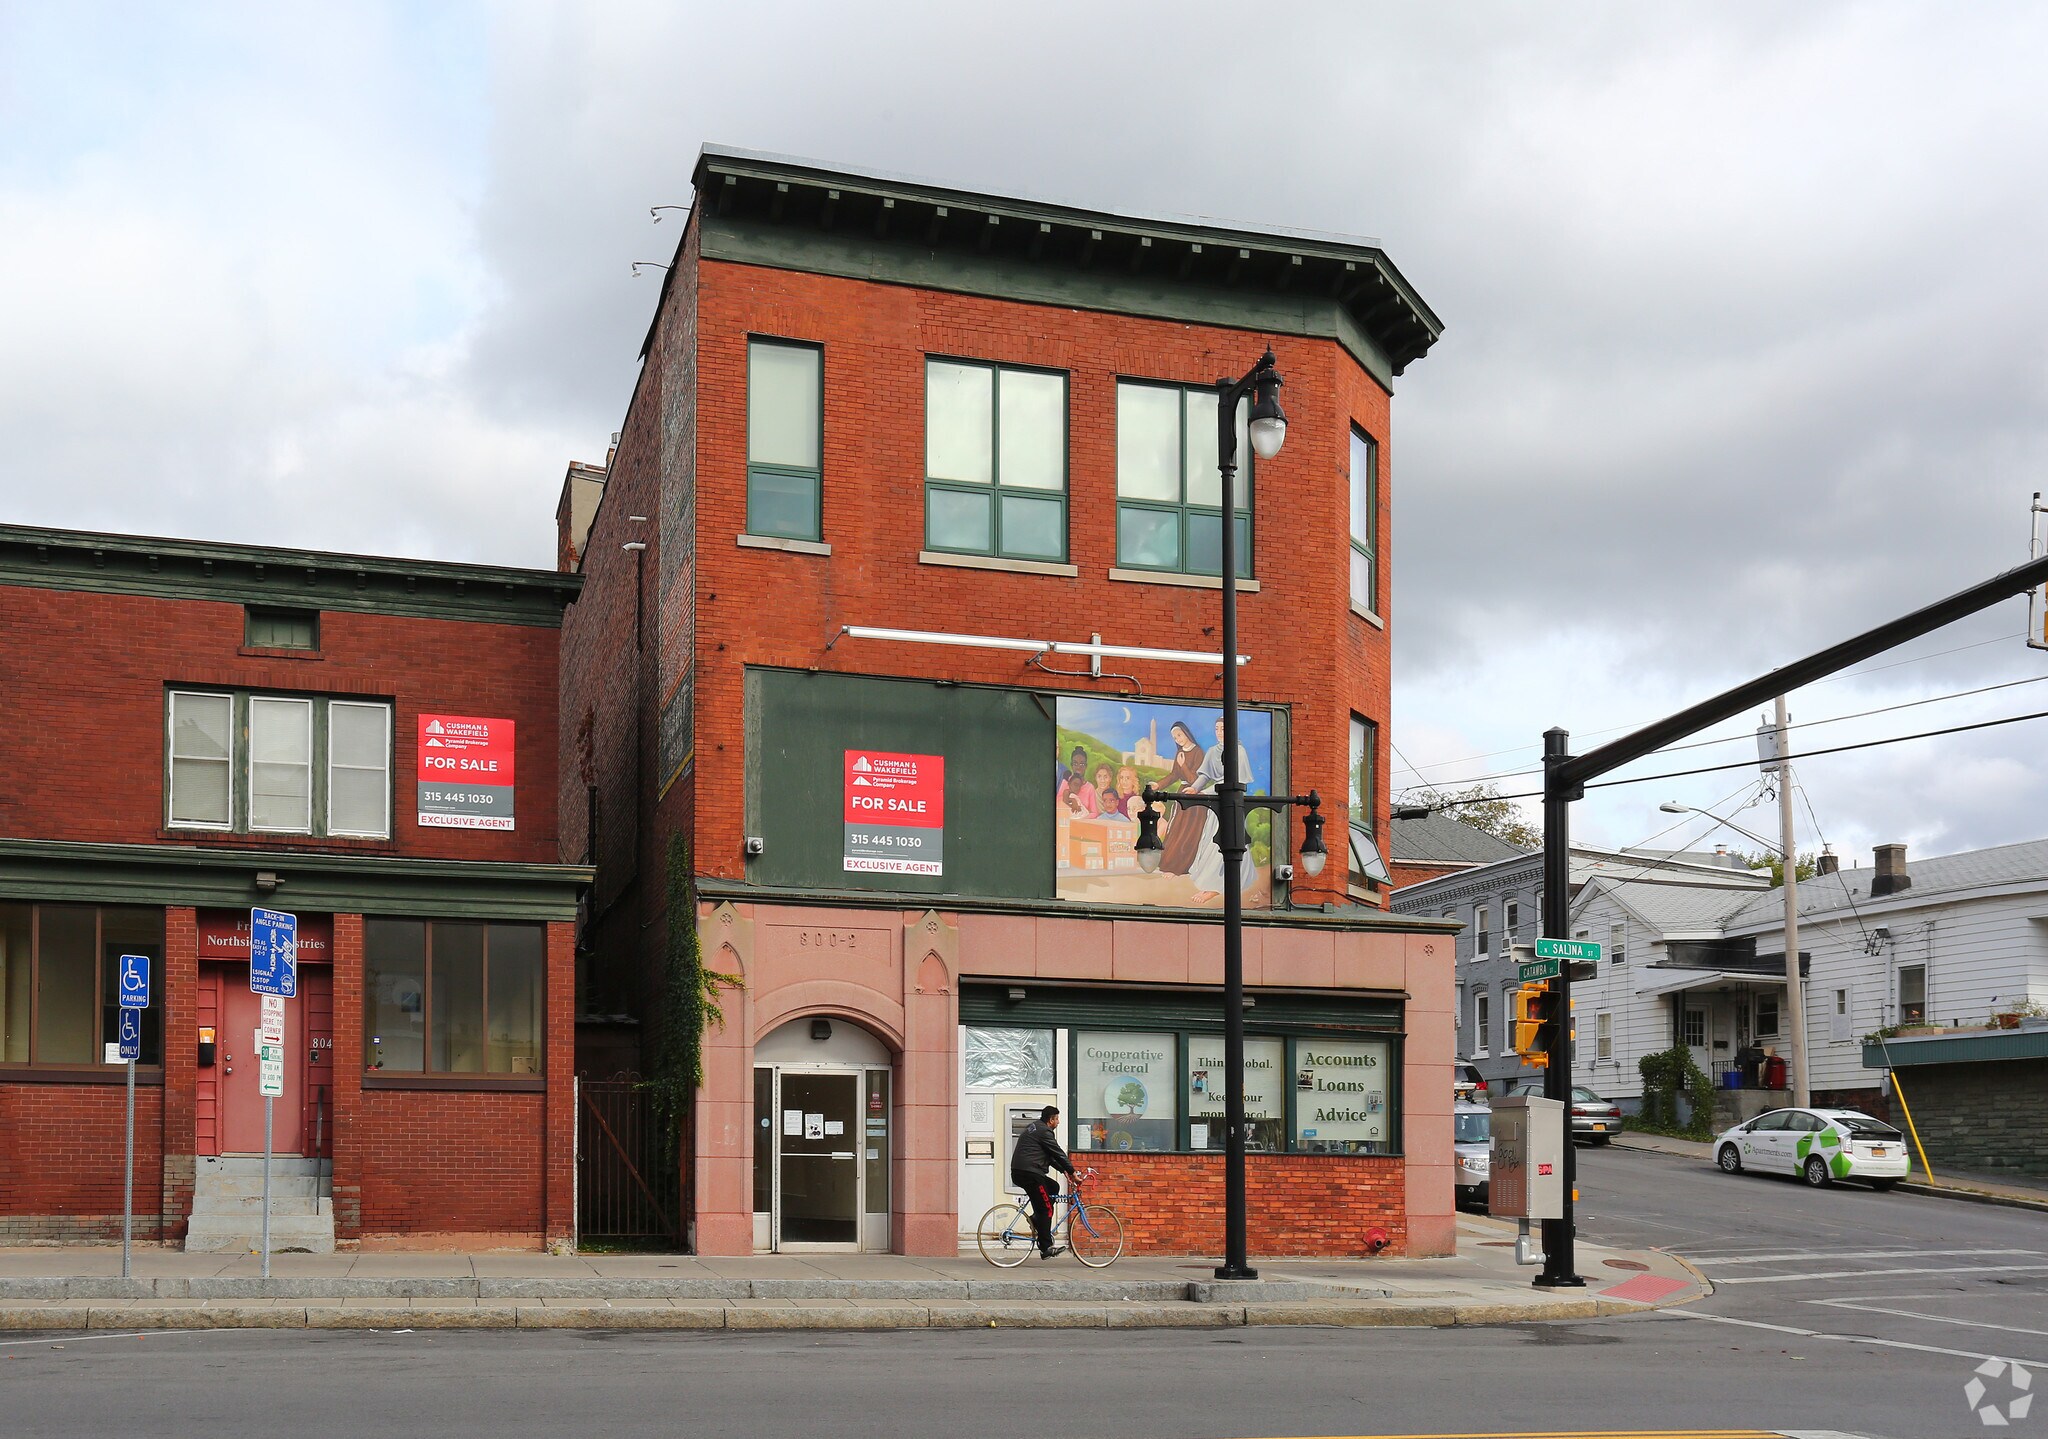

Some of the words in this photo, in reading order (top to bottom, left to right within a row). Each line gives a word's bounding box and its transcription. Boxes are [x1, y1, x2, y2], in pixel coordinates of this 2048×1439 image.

[446, 722, 481, 731] CUSHMAN
[446, 729, 489, 737] WAKEFIELD
[425, 756, 455, 769] FOR
[460, 759, 497, 771] SALE
[874, 759, 910, 768] CUSHMAN
[874, 766, 917, 775] WAKEFIELD
[425, 792, 441, 801] 315
[444, 793, 465, 802] 445
[467, 794, 494, 804] 1030
[852, 796, 883, 810] FOR
[888, 799, 926, 813] SALE
[421, 815, 475, 826] EXCLUSIVE
[478, 818, 511, 827] AGENT
[851, 834, 868, 844] 315
[872, 835, 893, 846] 445
[896, 836, 922, 847] 1030
[846, 860, 902, 871] EXCLUSIVE
[905, 863, 939, 873] AGENT
[264, 912, 285, 922] BACK-IN
[255, 918, 271, 927] ANGLE
[272, 920, 293, 931] PARKING
[207, 935, 250, 947] Northsi
[1552, 943, 1583, 956] SALINA
[122, 994, 146, 1003] PARKING
[269, 999, 277, 1008] NO
[312, 1037, 332, 1049] 804
[120, 1045, 138, 1055] ONLY
[1087, 1047, 1164, 1061] Cooperative
[1197, 1057, 1224, 1067] Thin
[1305, 1052, 1377, 1067] Accounts
[1101, 1061, 1149, 1073] Federal
[1317, 1078, 1364, 1092] Loans
[1208, 1092, 1226, 1102] Kee
[1200, 1111, 1225, 1119] mon
[1315, 1108, 1367, 1122] Advice
[1752, 1146, 1793, 1158] Apartments.com
